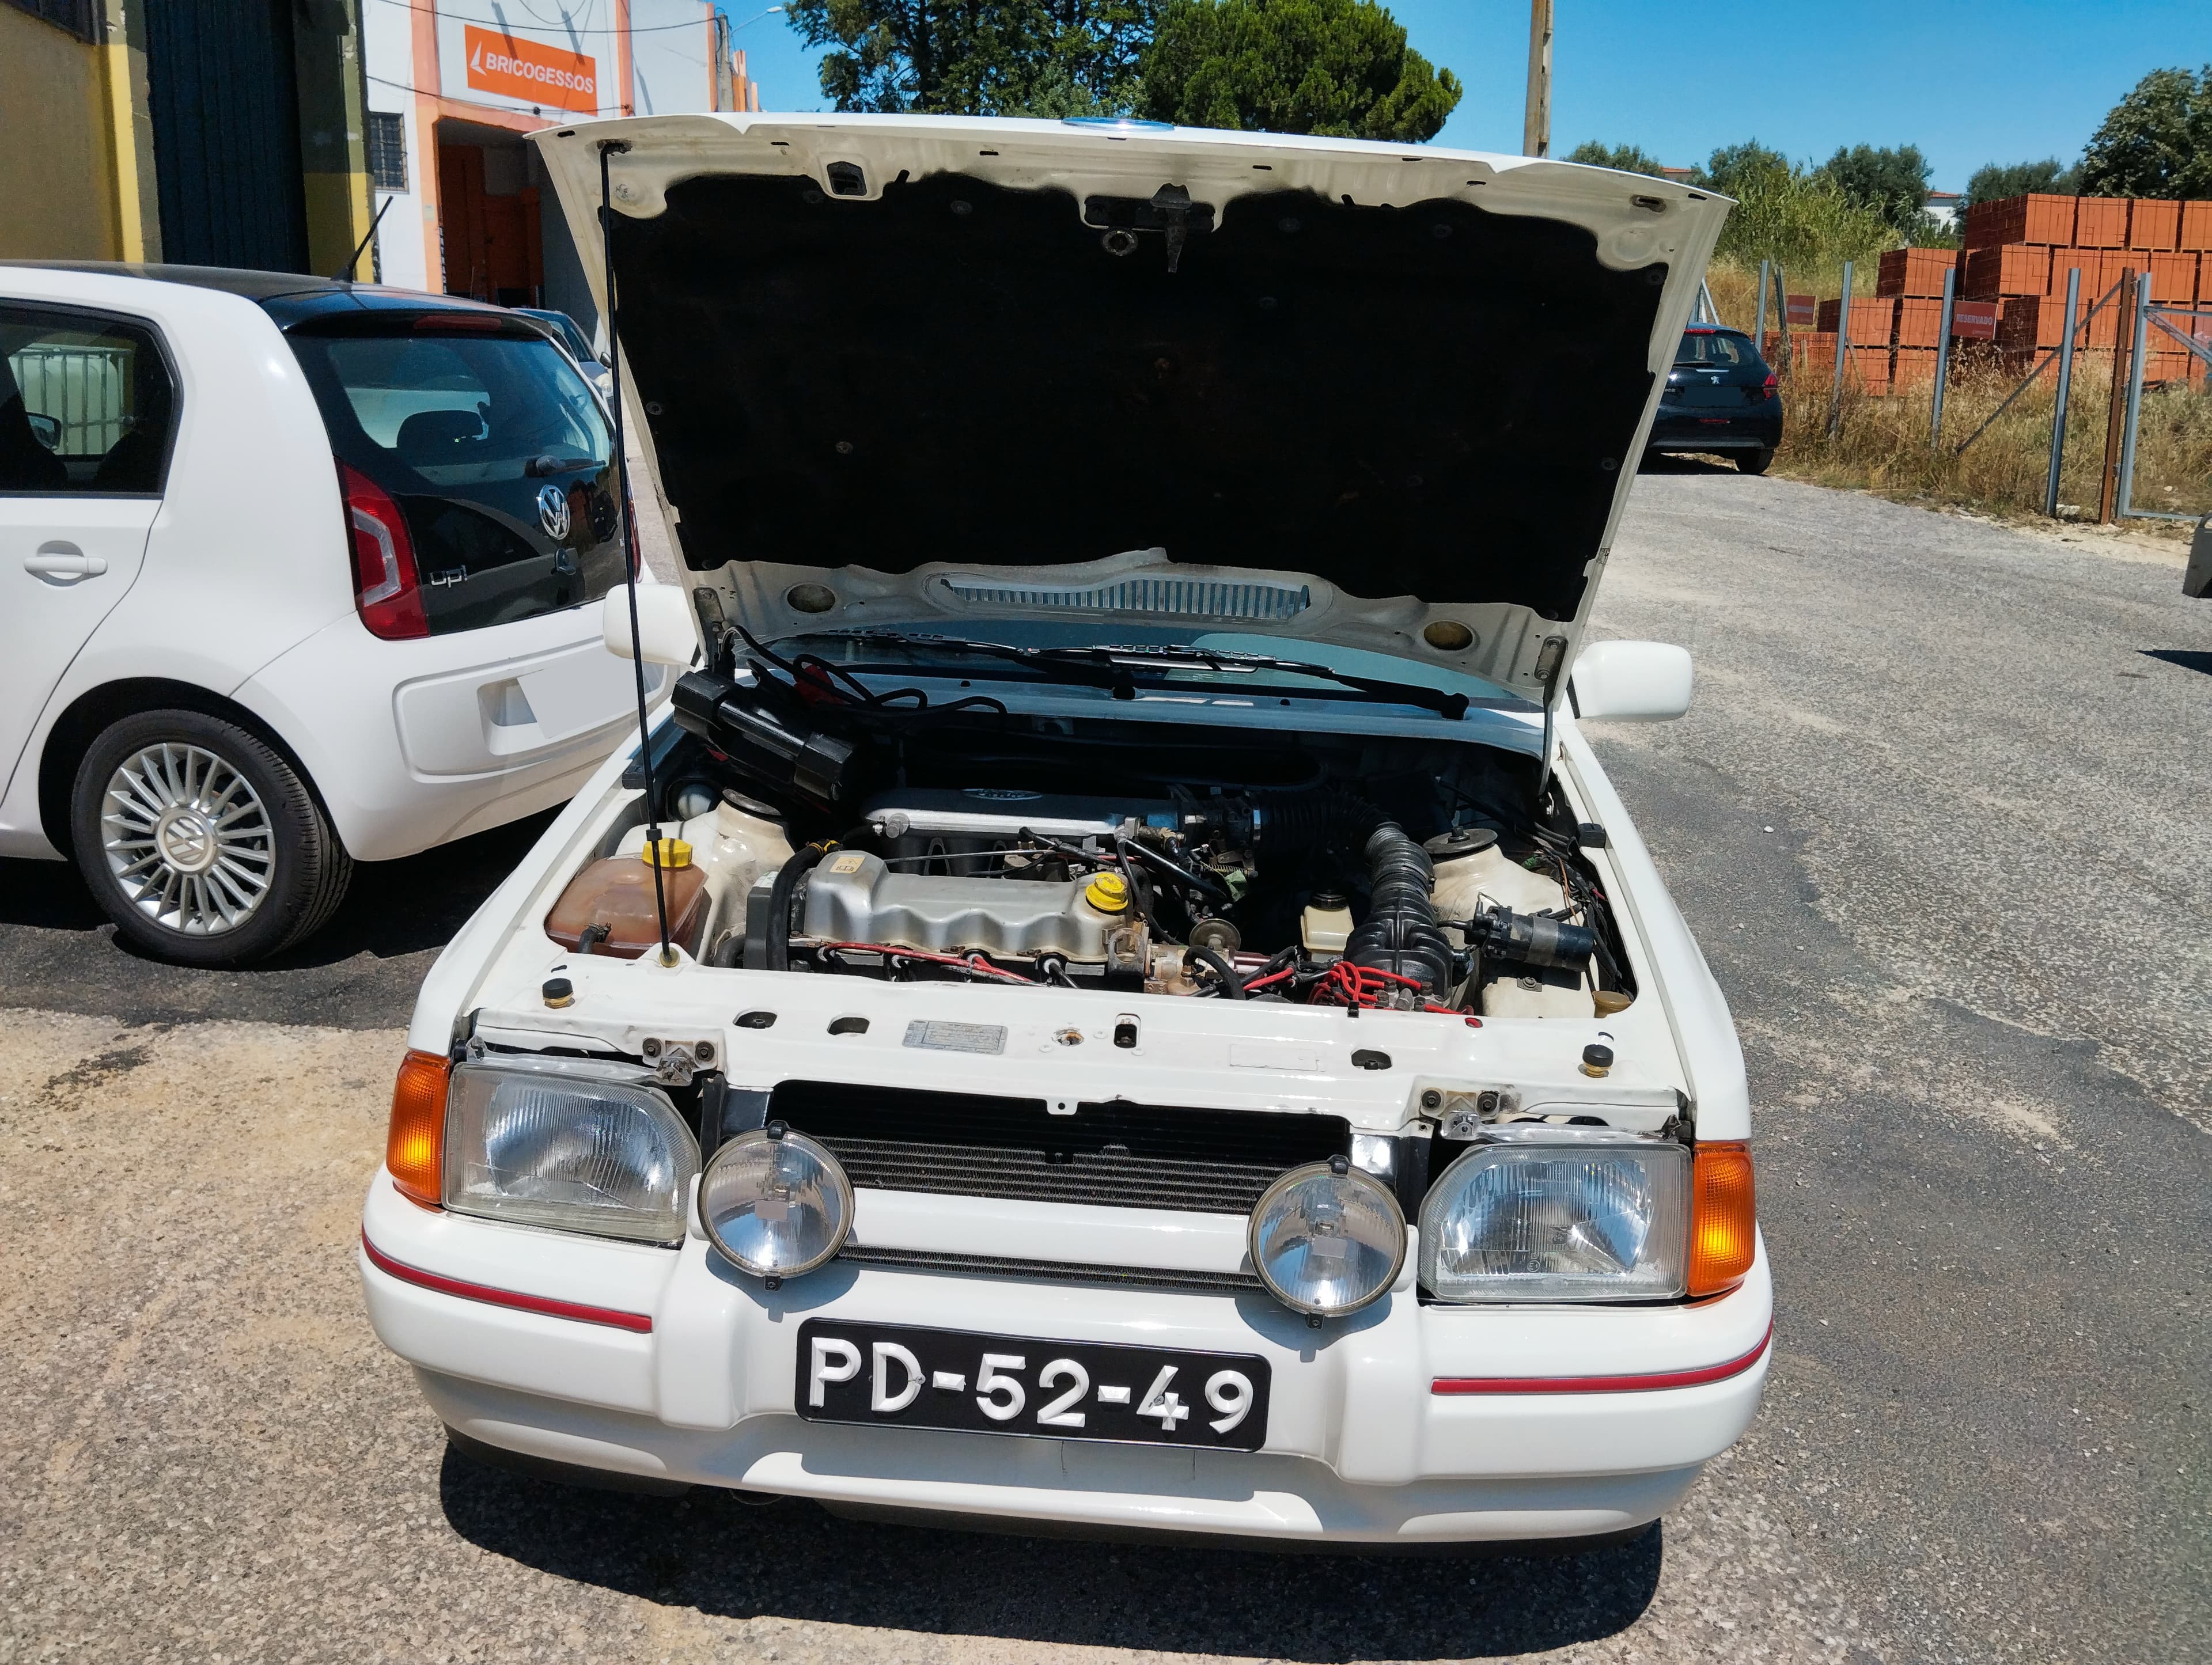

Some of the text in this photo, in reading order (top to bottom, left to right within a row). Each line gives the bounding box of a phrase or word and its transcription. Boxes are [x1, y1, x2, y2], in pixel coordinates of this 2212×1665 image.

[486, 52, 593, 94] BRICOGESSOS
[429, 565, 468, 588] up!
[809, 1337, 1253, 1434] PD-52-49
